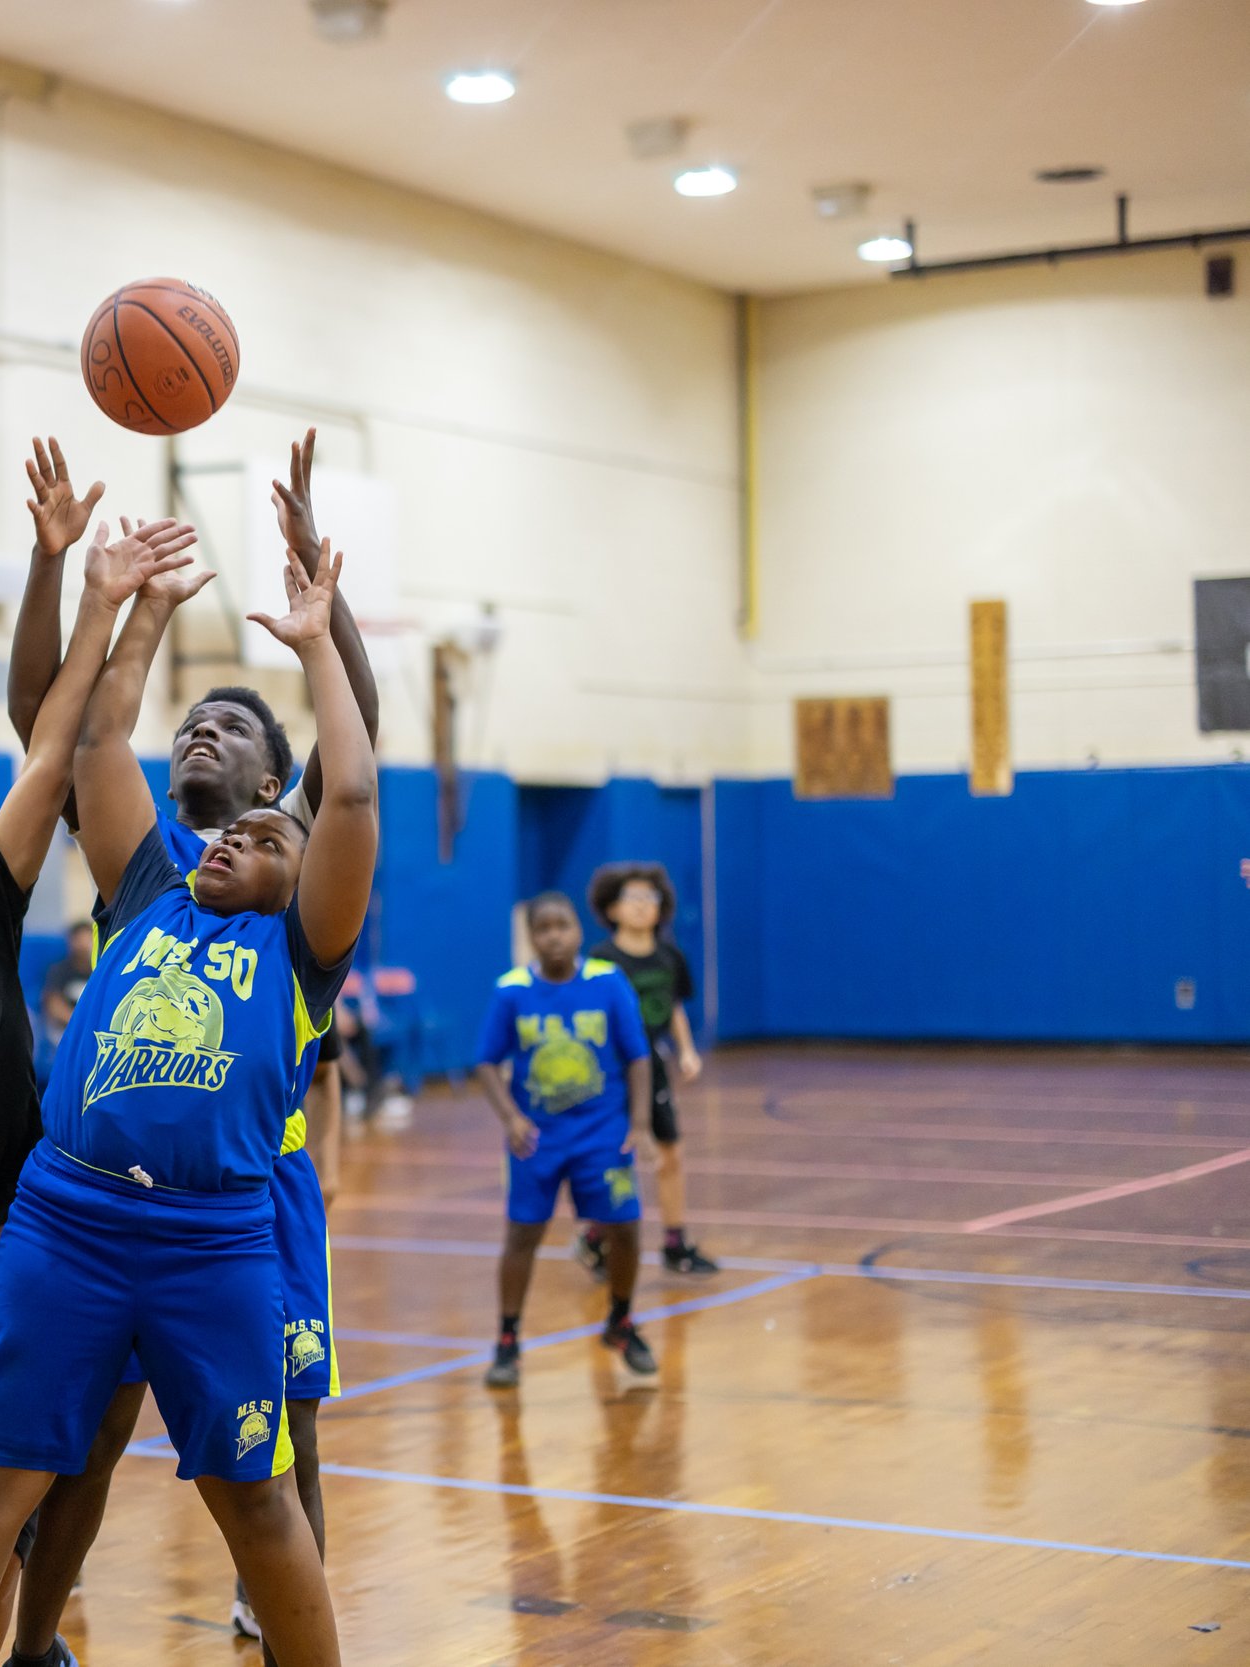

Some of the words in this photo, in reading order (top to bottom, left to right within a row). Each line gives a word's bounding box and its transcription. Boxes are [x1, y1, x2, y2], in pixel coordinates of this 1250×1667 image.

[177, 306, 234, 387] EVOLUTION
[203, 940, 258, 1001] 50
[83, 1042, 234, 1103] WARRIORS
[311, 1318, 325, 1333] 50
[290, 1348, 326, 1376] WARRIORS
[237, 1401, 257, 1419] M.S.
[260, 1400, 273, 1414] 50
[235, 1430, 271, 1460] WARRIORS
